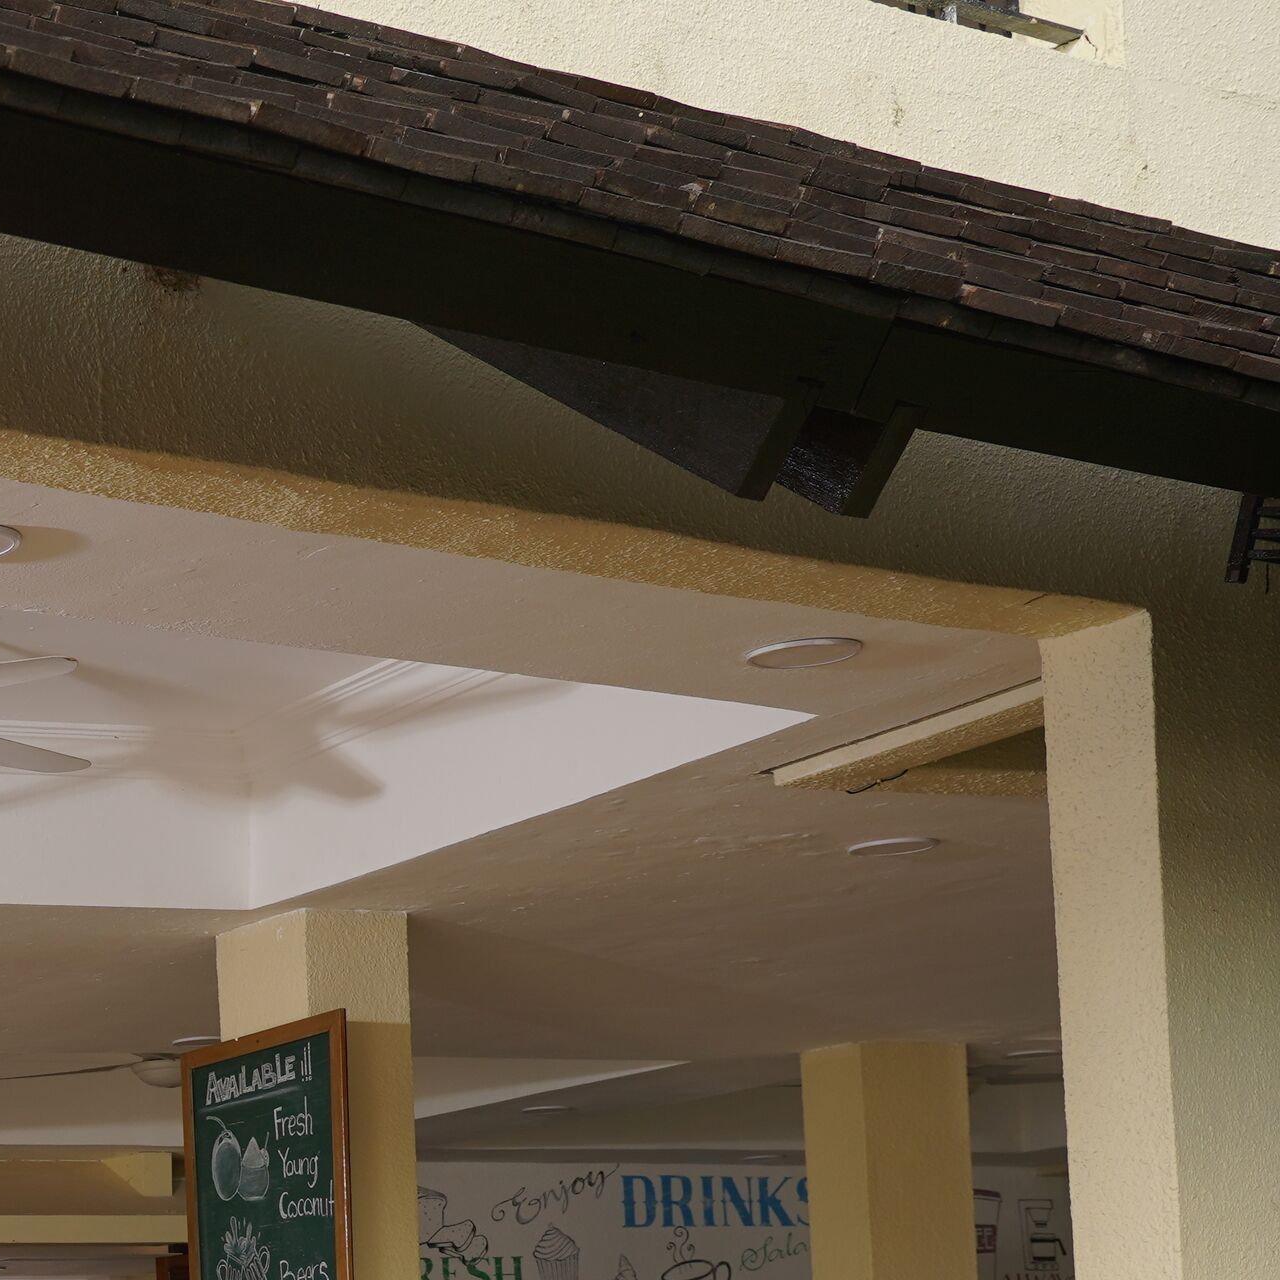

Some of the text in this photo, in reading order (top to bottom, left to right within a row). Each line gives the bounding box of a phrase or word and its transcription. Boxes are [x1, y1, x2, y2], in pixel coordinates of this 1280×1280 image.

[206, 1053, 297, 1106] AVAILABLE
[273, 1096, 314, 1141] Fresh
[277, 1147, 319, 1188] Young
[278, 1180, 335, 1219] Coconut
[491, 1163, 620, 1225] Enjoy
